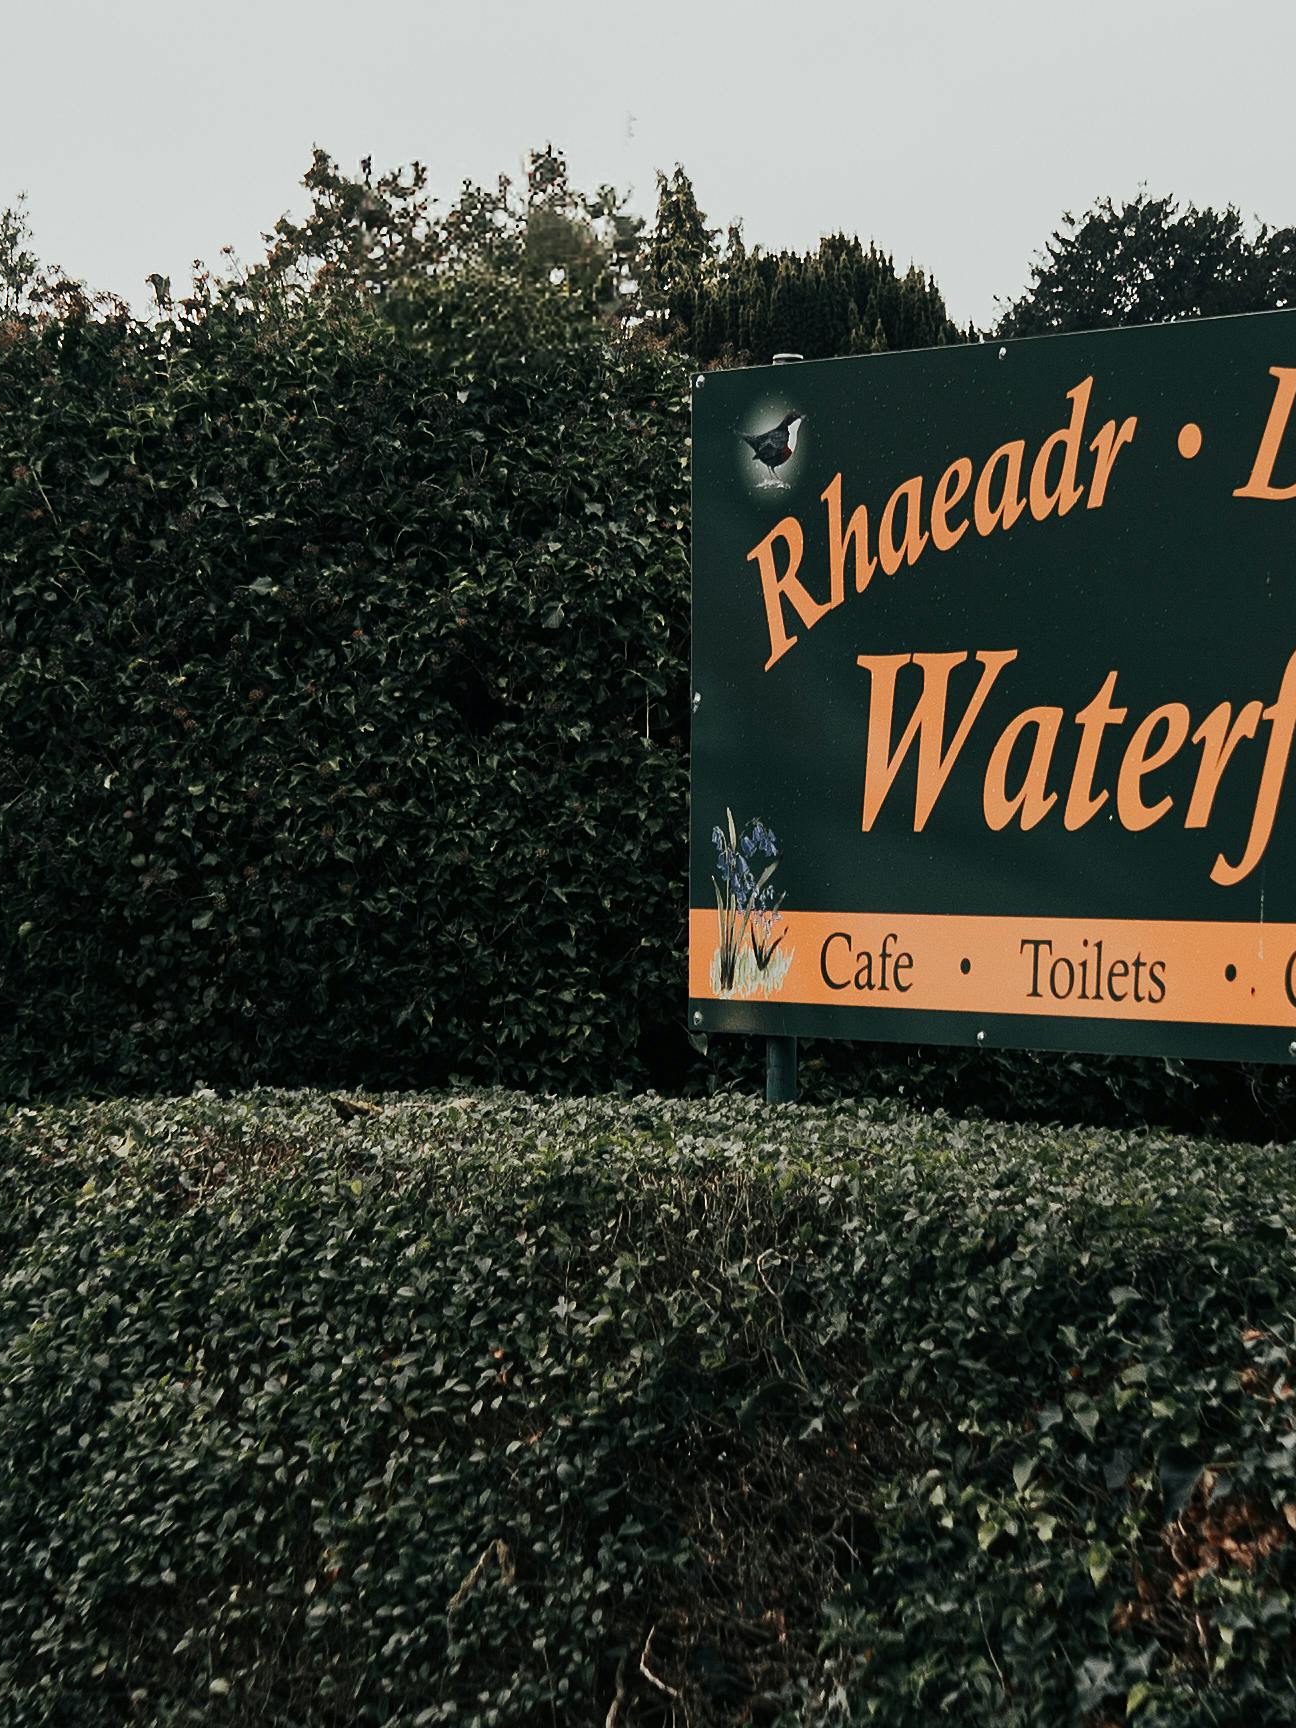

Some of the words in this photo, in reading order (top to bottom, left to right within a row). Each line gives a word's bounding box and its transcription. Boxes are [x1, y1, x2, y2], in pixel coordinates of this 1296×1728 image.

[746, 375, 1138, 673] Rhaeadr
[820, 932, 914, 994] Cafe
[1019, 938, 1167, 1005] Toilets
